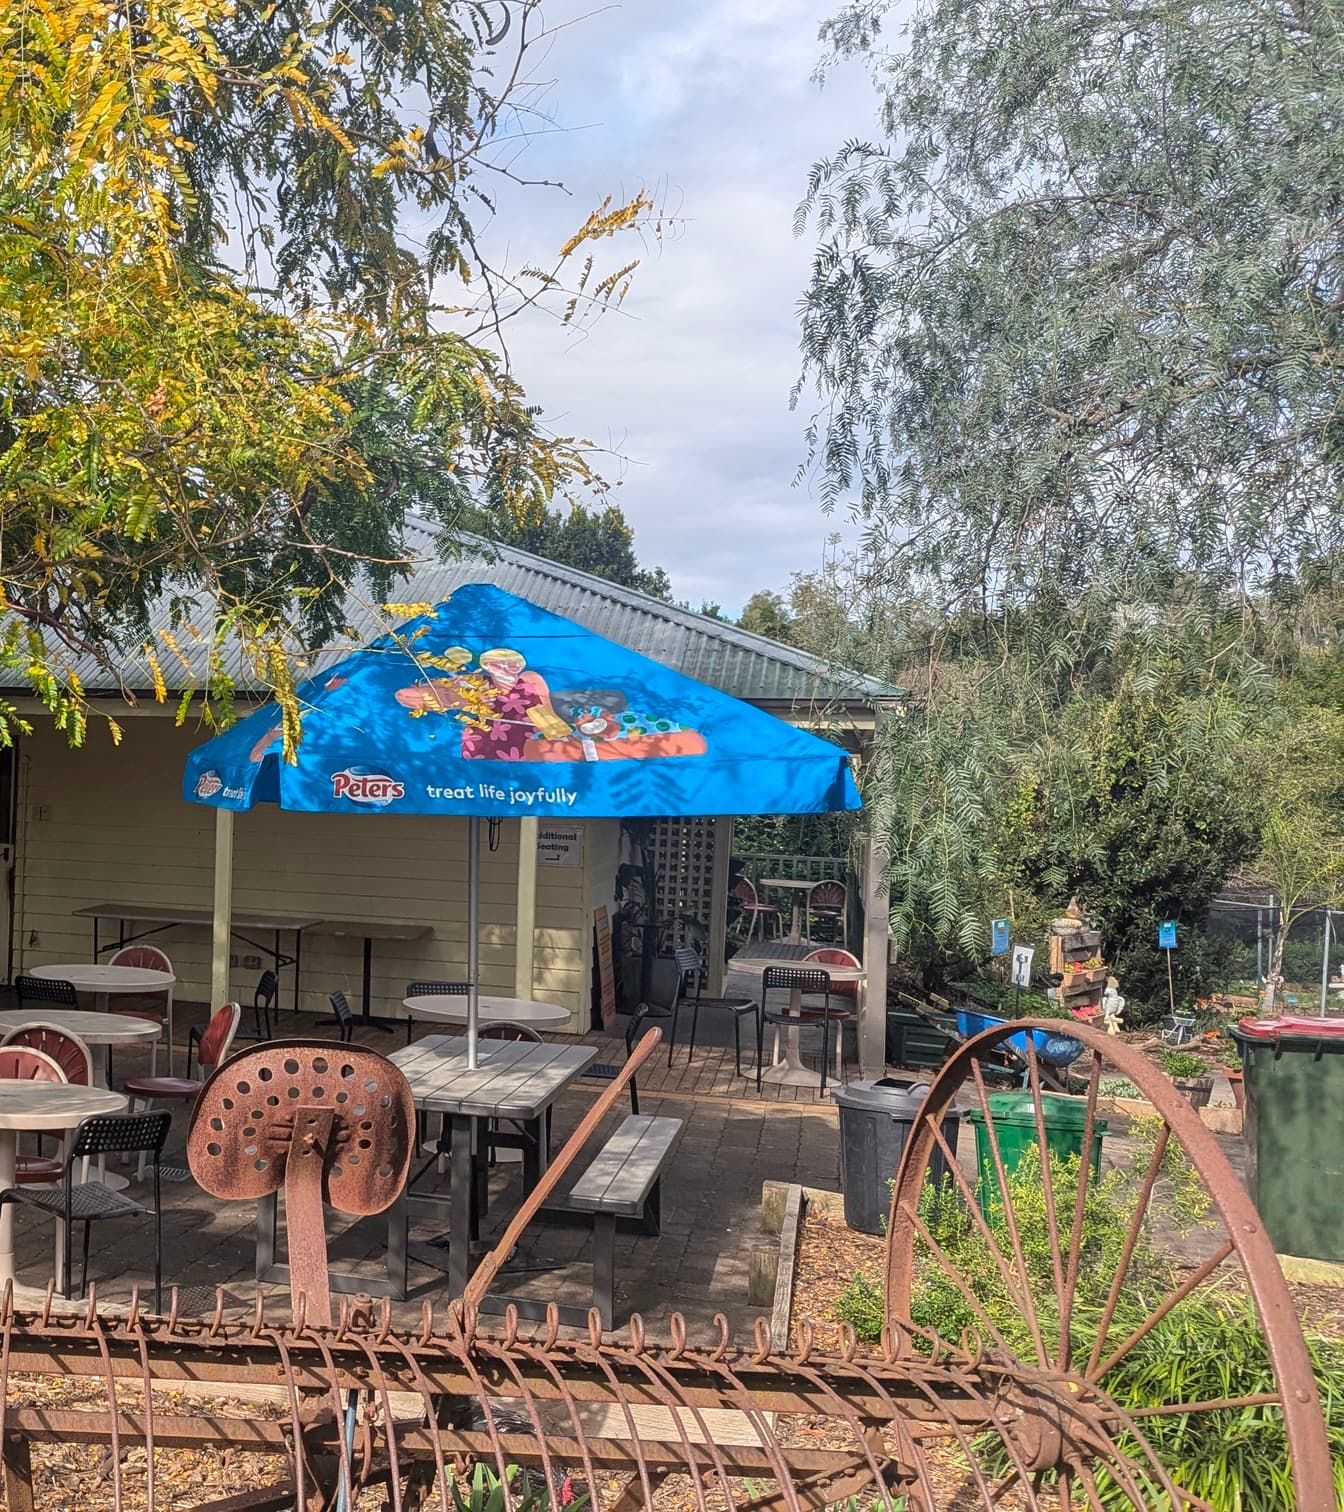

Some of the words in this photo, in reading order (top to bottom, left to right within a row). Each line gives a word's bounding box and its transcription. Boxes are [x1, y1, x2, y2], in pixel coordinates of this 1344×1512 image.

[331, 774, 404, 798] Peters
[426, 784, 474, 799] treat
[479, 784, 505, 800] life
[510, 787, 577, 806] joyfully
[537, 831, 577, 841] dditional
